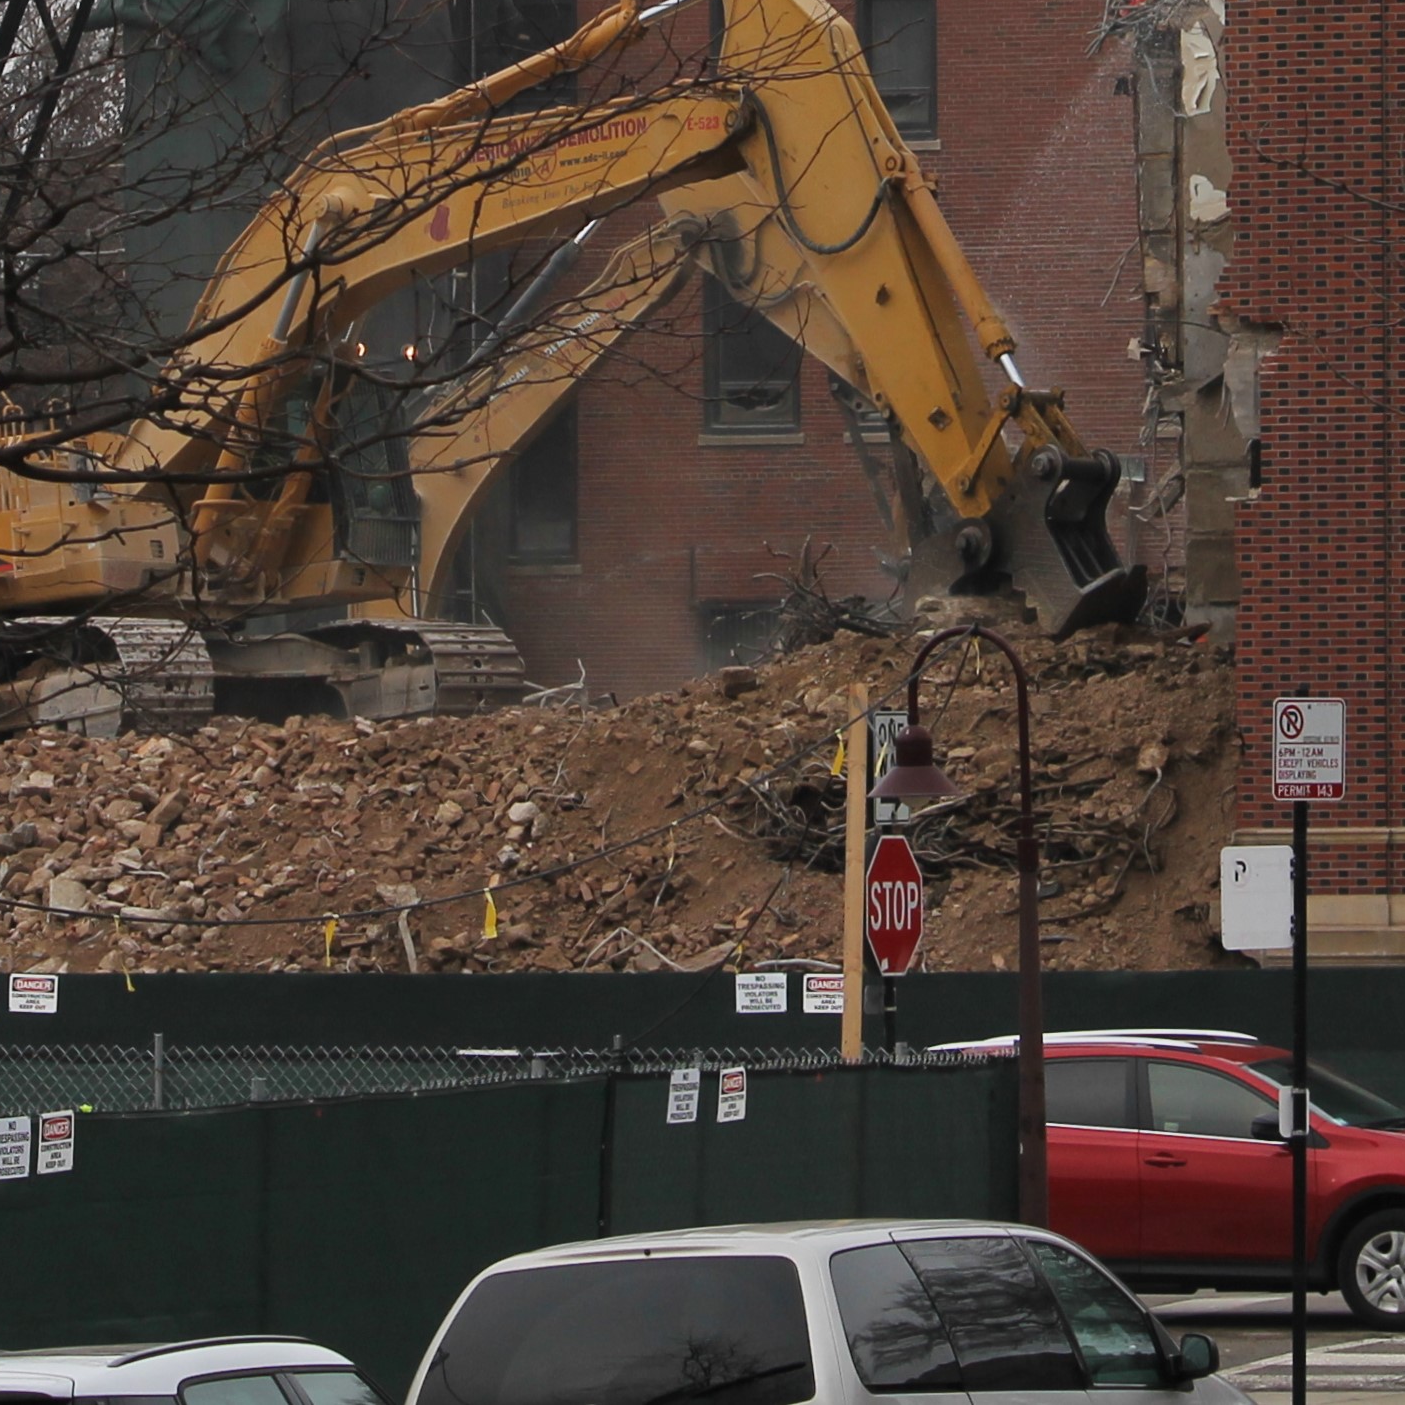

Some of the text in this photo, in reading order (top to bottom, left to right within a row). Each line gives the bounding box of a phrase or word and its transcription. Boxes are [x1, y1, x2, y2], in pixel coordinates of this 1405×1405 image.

[557, 117, 646, 148] DEMOLITION
[1279, 748, 1324, 757] 6PM 12AM
[1279, 758, 1339, 768] EXCEPT VEHICLES
[1278, 770, 1317, 779] DISPLAYING
[1278, 784, 1333, 797] PERMIT 143
[871, 880, 919, 930] STOP
[811, 980, 843, 989] DANGE
